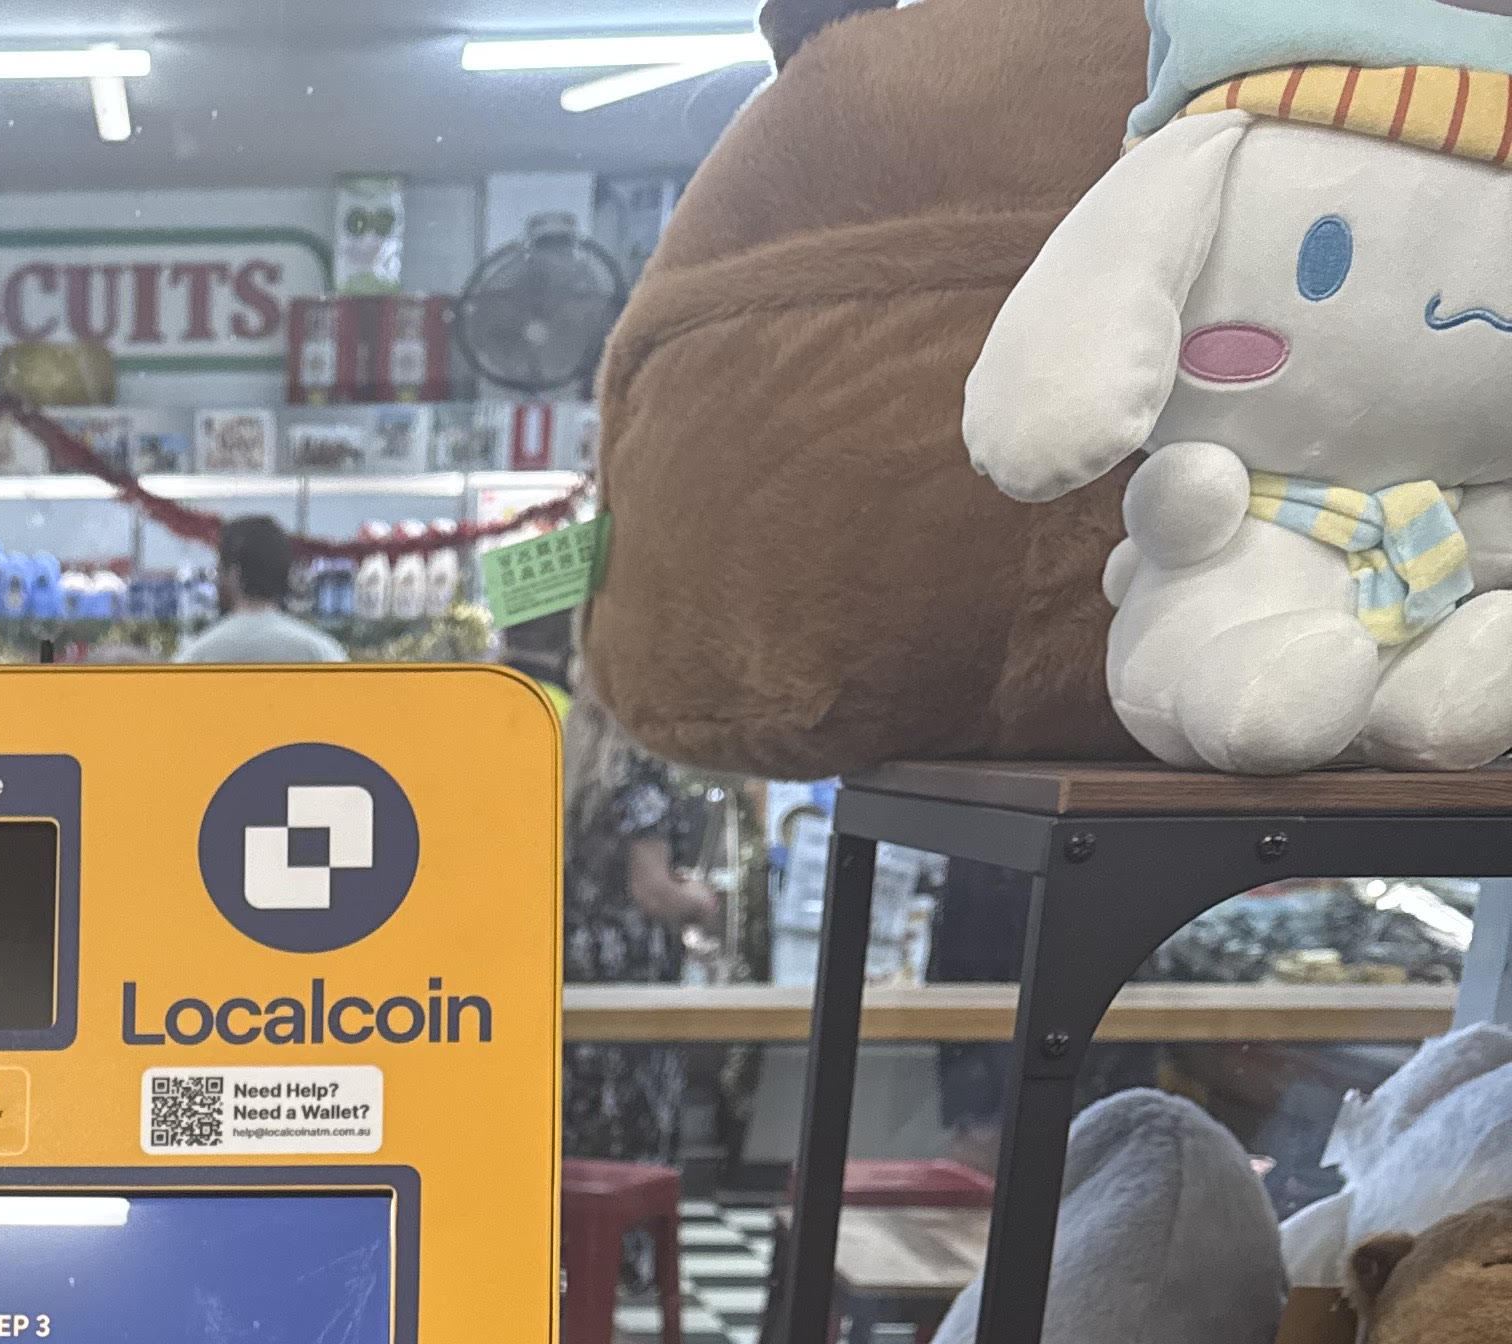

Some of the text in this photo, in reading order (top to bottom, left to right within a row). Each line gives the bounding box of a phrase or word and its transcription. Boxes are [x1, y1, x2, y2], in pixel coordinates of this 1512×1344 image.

[122, 977, 492, 1045] Localcoin
[233, 1083, 339, 1101] Need Help?
[233, 1104, 370, 1120] Need a Wallet?
[232, 1127, 371, 1139] help@localcoinatm.com.au
[36, 1316, 51, 1337] 3
